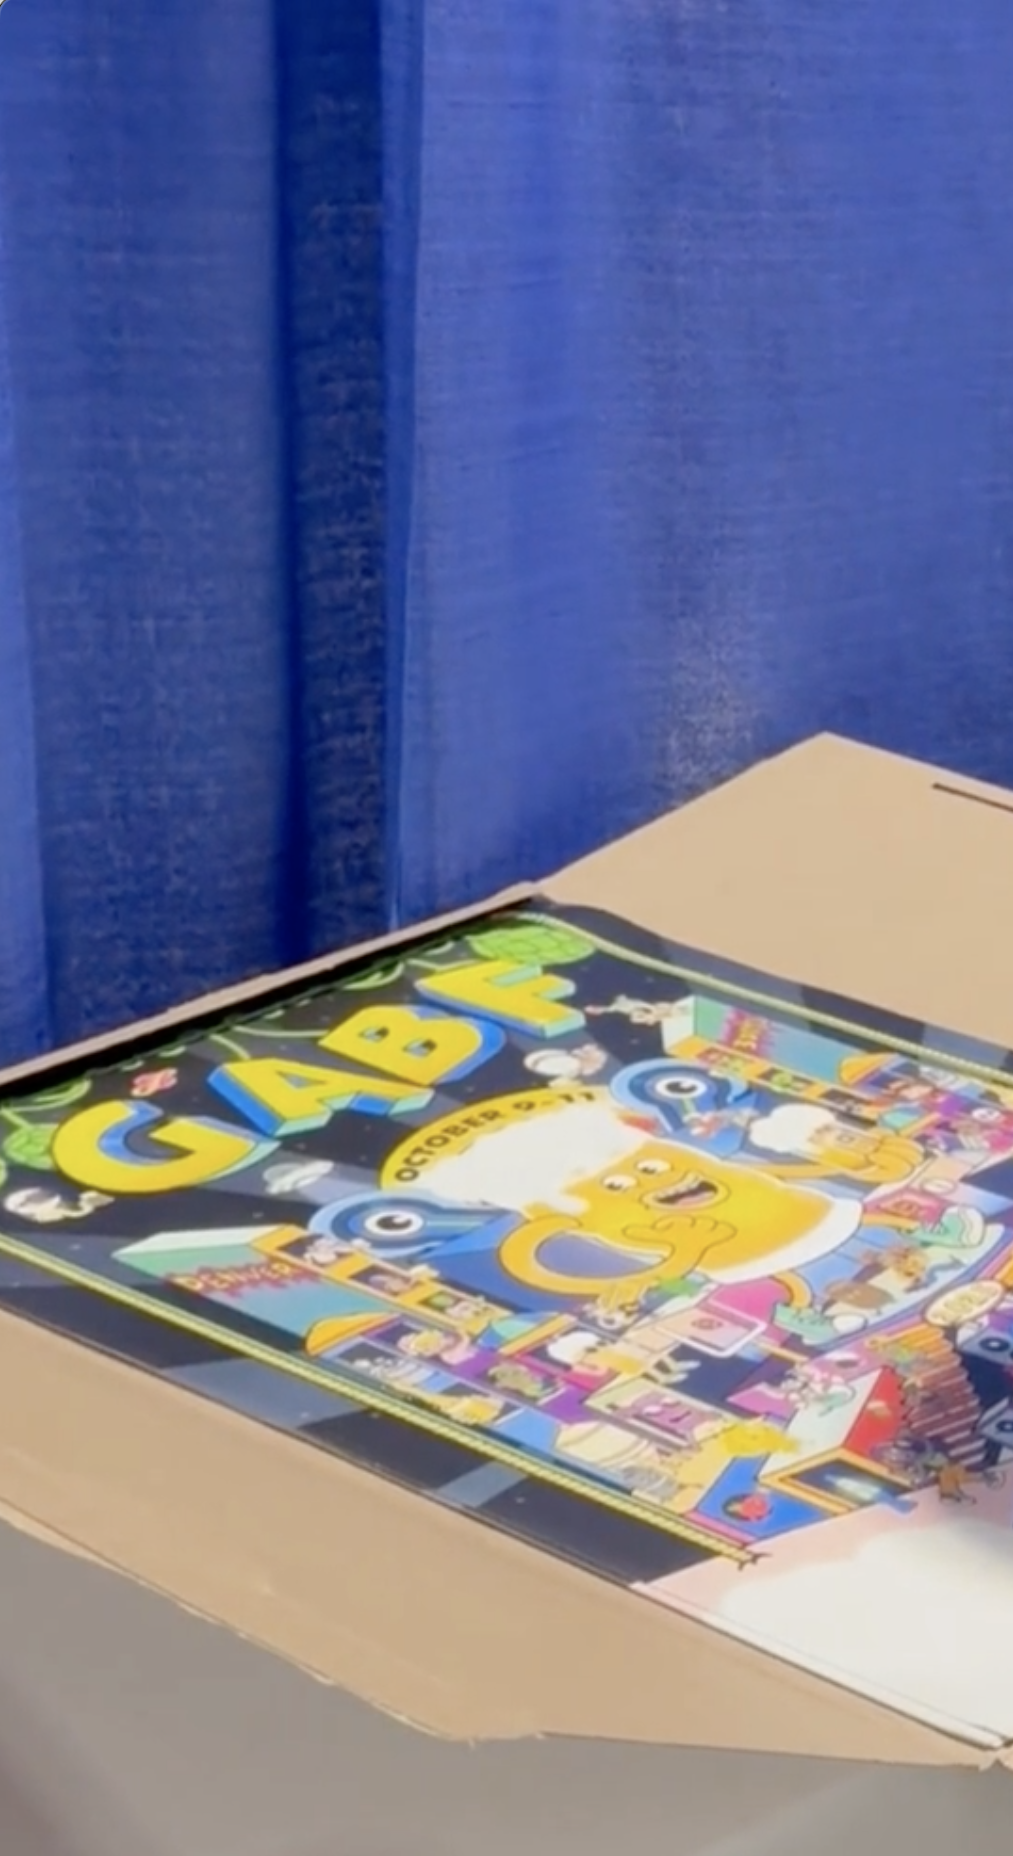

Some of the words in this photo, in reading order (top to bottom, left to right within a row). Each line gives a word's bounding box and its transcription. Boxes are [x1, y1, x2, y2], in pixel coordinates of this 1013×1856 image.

[50, 958, 587, 1194] GABF
[394, 1109, 506, 1182] OCTOBER
[171, 1260, 292, 1293] DENVER
